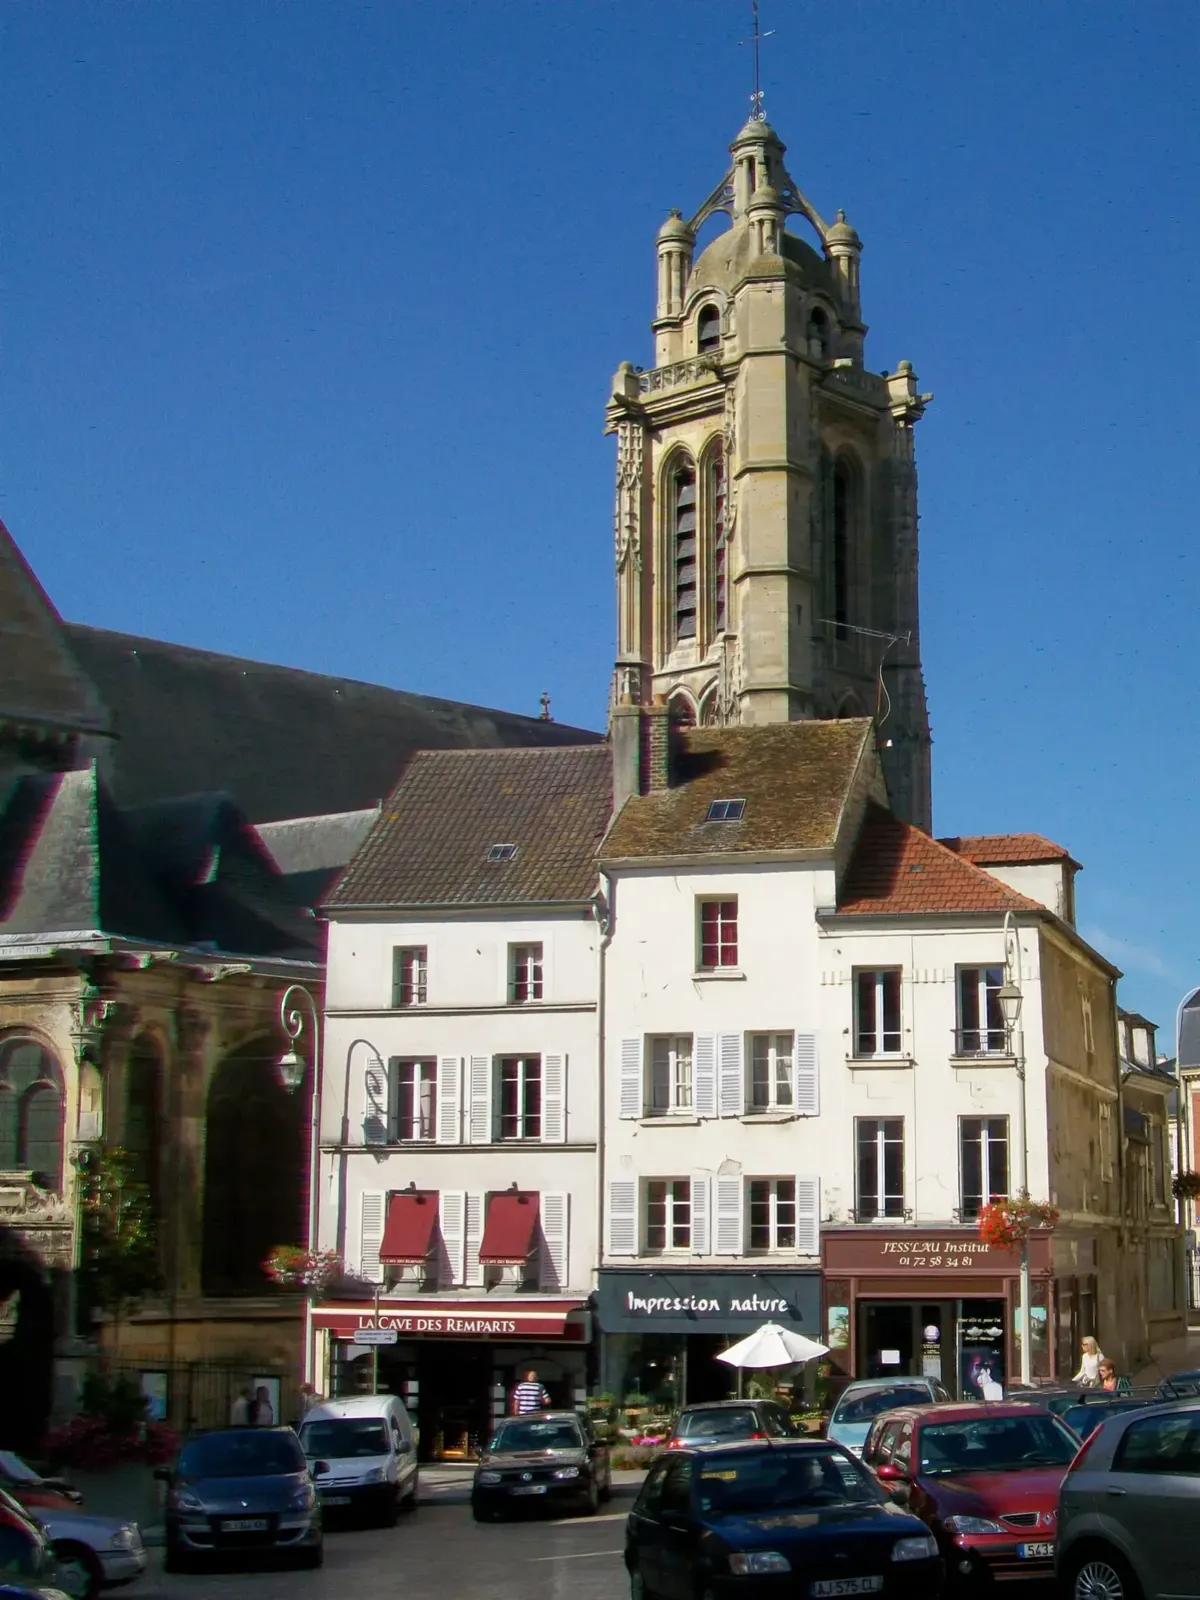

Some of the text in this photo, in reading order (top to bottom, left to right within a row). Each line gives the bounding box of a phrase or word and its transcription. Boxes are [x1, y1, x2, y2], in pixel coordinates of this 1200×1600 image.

[944, 1242, 989, 1253] Institut
[899, 1256, 973, 1267] 01 72 58 34 81
[627, 1291, 788, 1314] Impression nature
[358, 1316, 516, 1332] LA CAVE DES REMPARTS
[835, 1580, 859, 1594] 575
